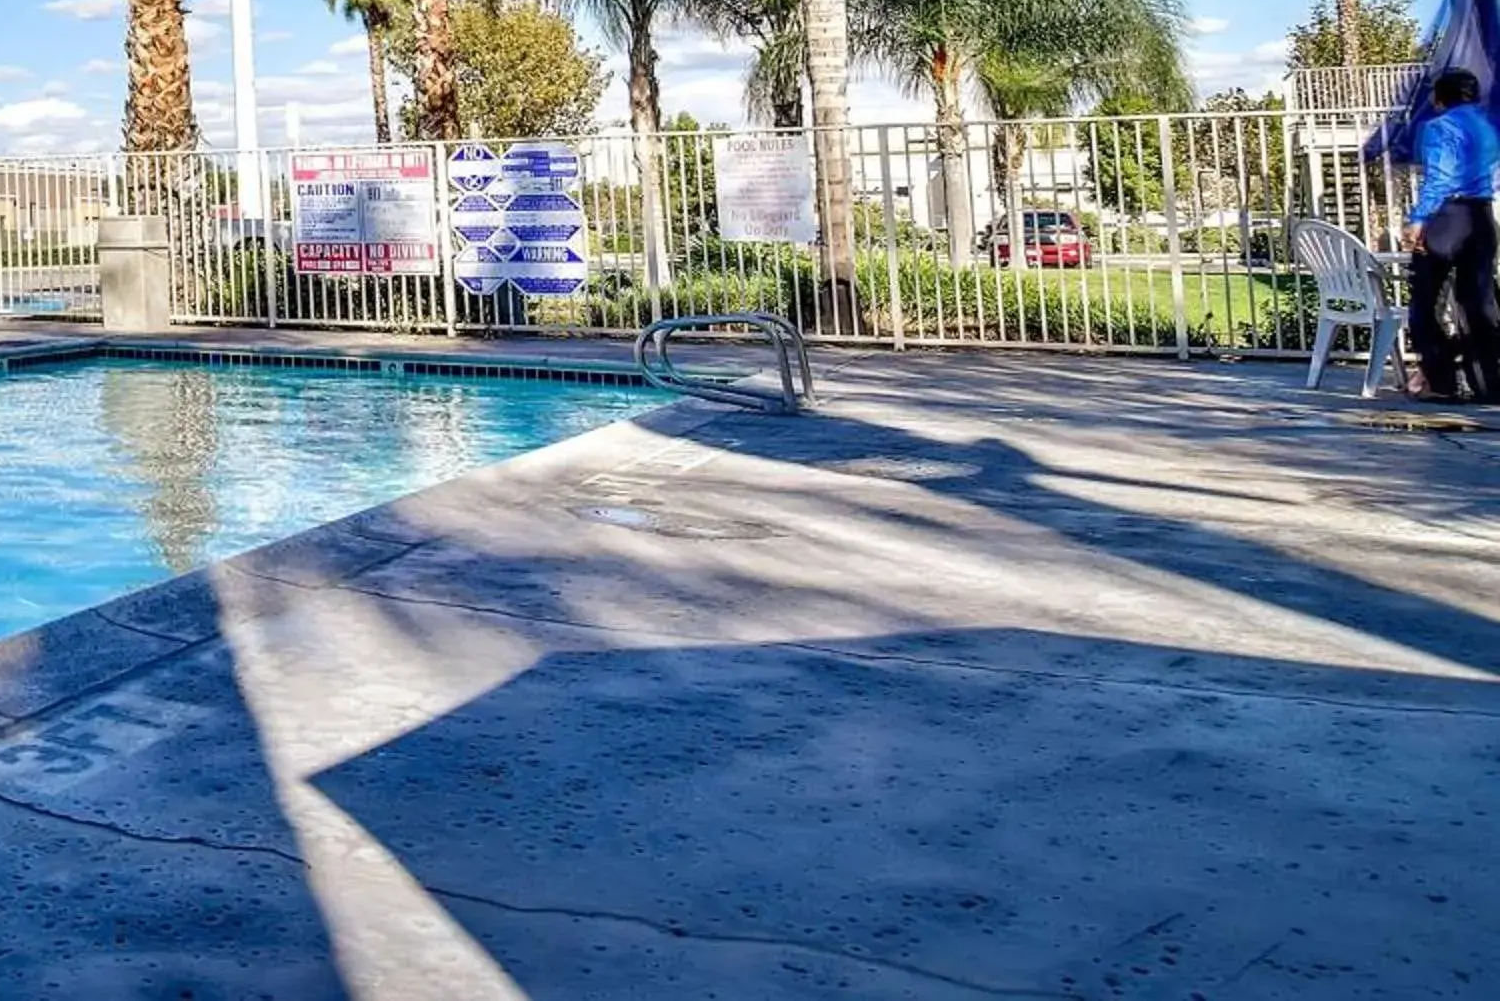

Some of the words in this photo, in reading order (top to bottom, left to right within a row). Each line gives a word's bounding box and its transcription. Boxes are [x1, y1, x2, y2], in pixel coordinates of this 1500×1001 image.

[727, 140, 756, 152] POOL
[297, 183, 355, 196] CAUTION
[299, 244, 360, 258] CAPACITY
[369, 244, 385, 259] NO
